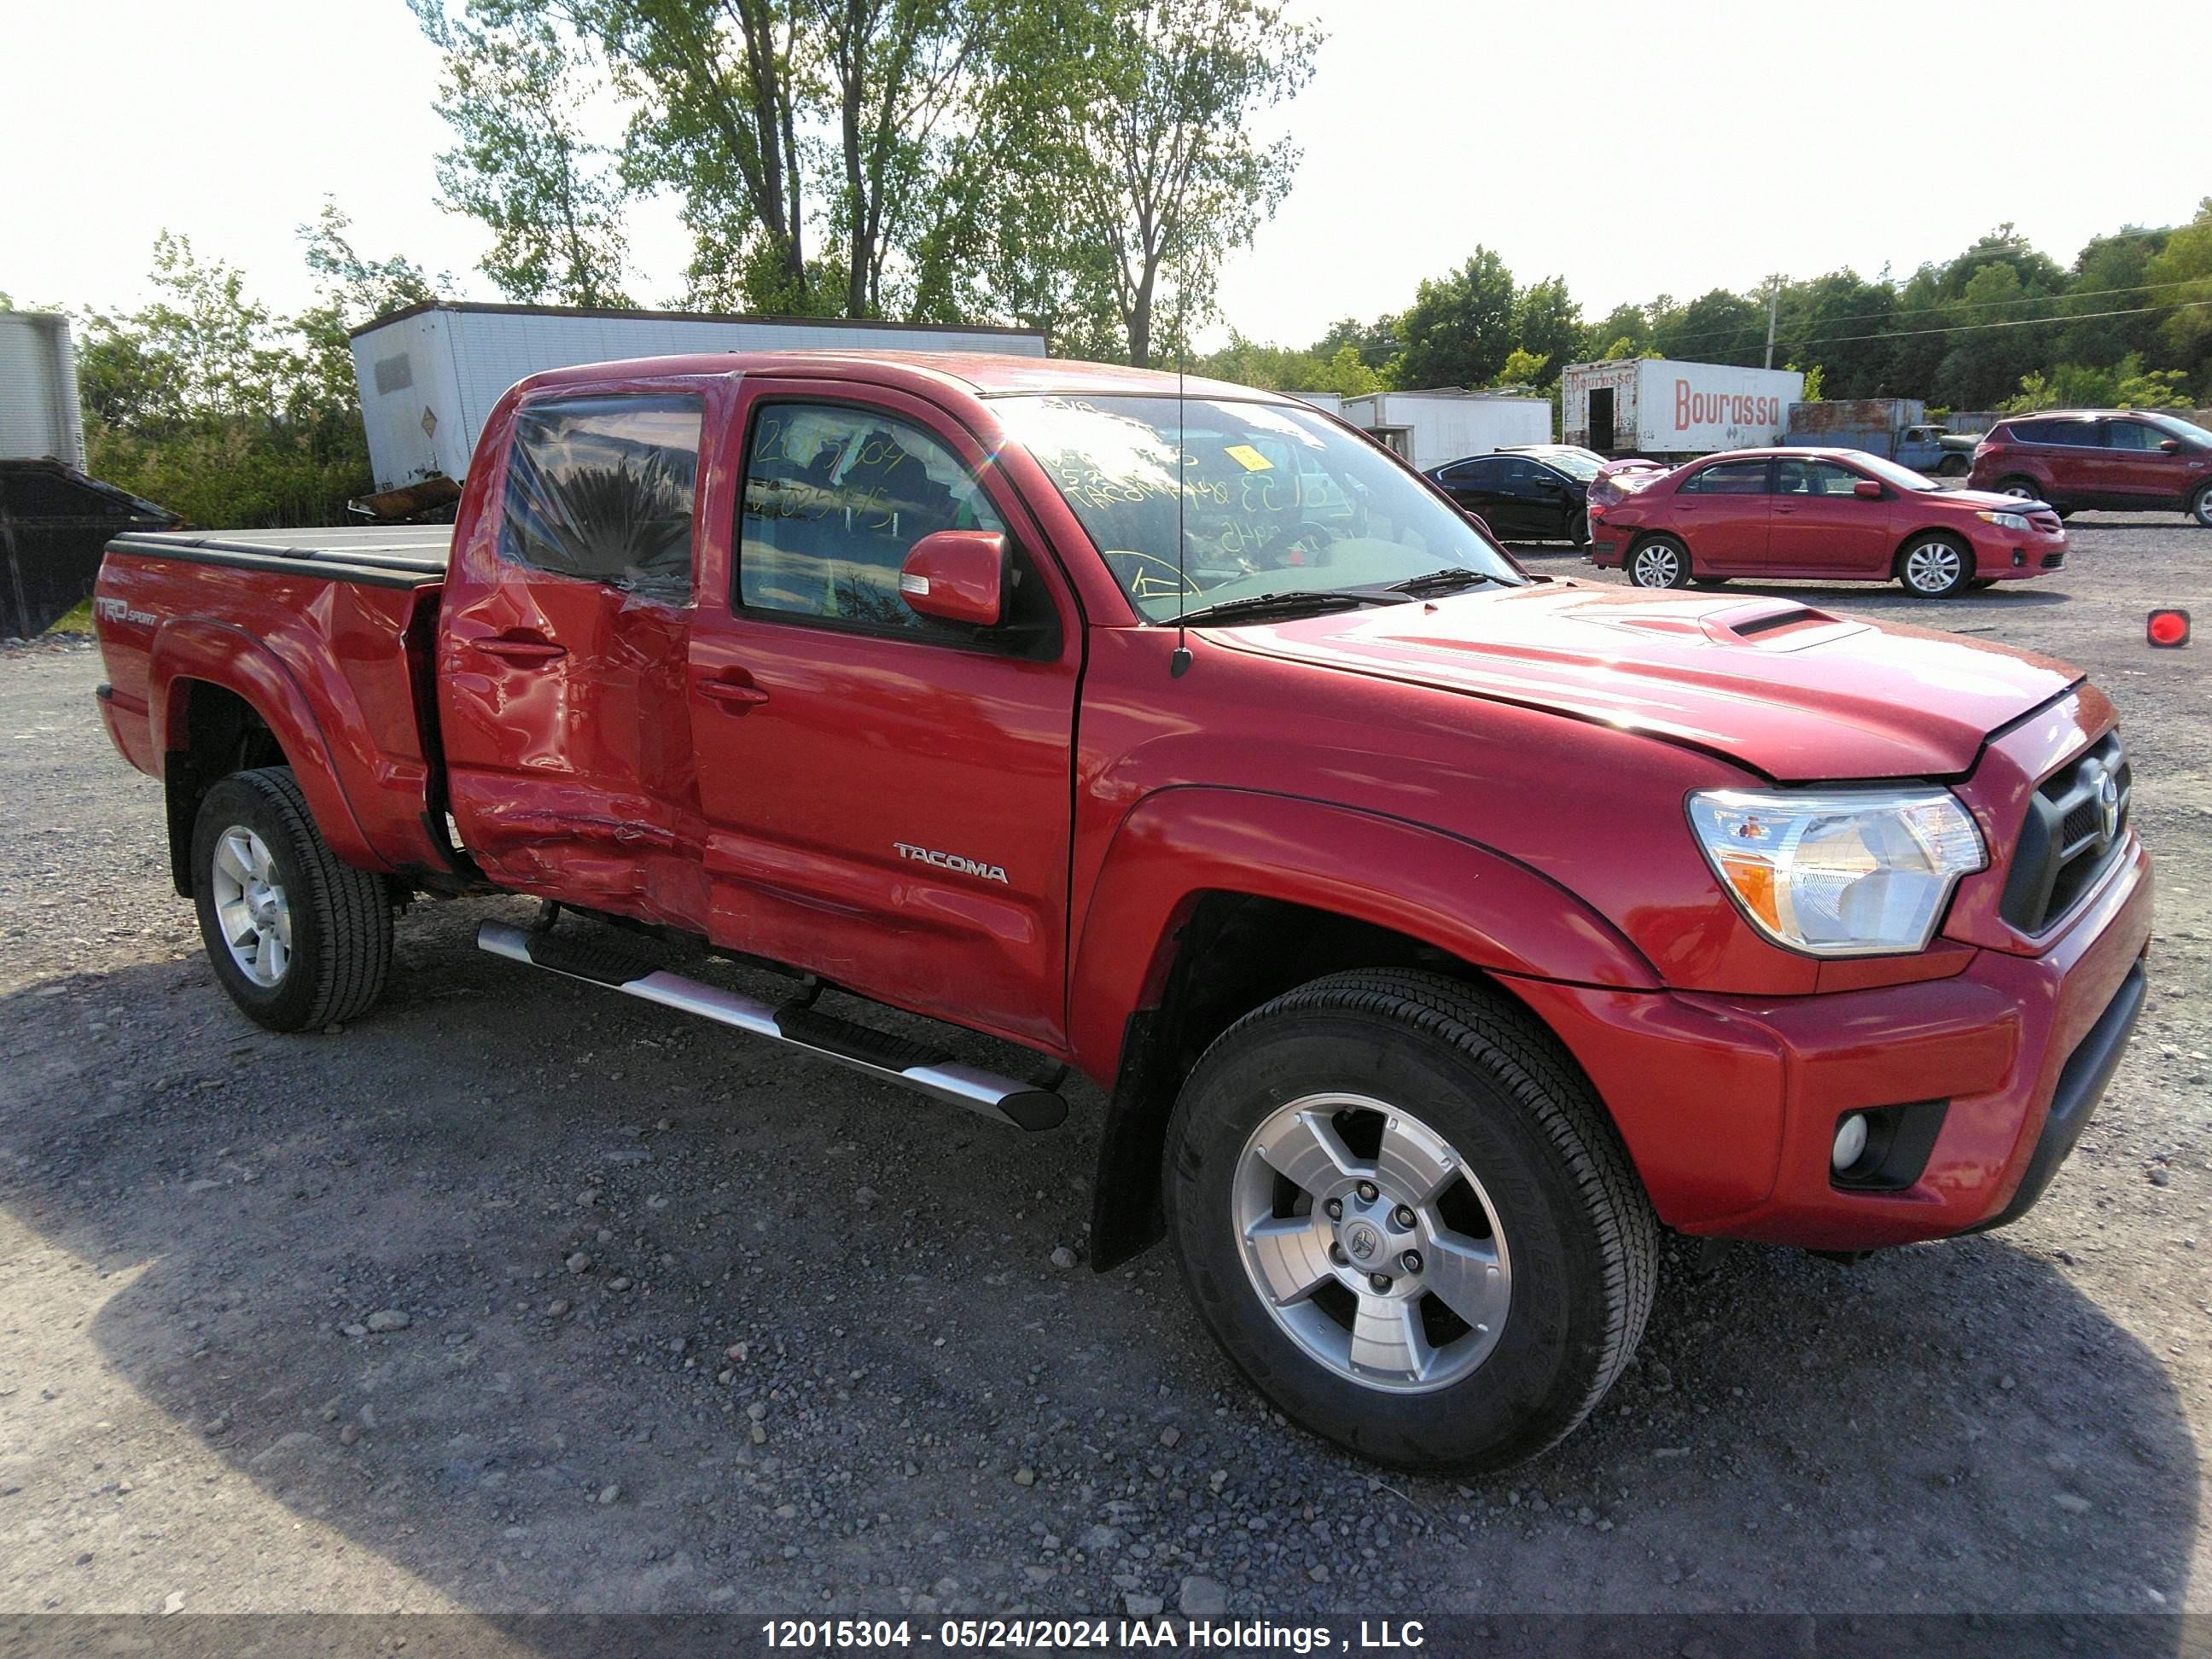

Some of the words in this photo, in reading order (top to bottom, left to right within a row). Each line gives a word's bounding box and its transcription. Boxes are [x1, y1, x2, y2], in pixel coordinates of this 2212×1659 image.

[1675, 379, 1779, 431] Bourassa
[96, 597, 128, 624] TRD
[127, 610, 158, 626] SPORT
[893, 842, 1009, 884] TACOMA
